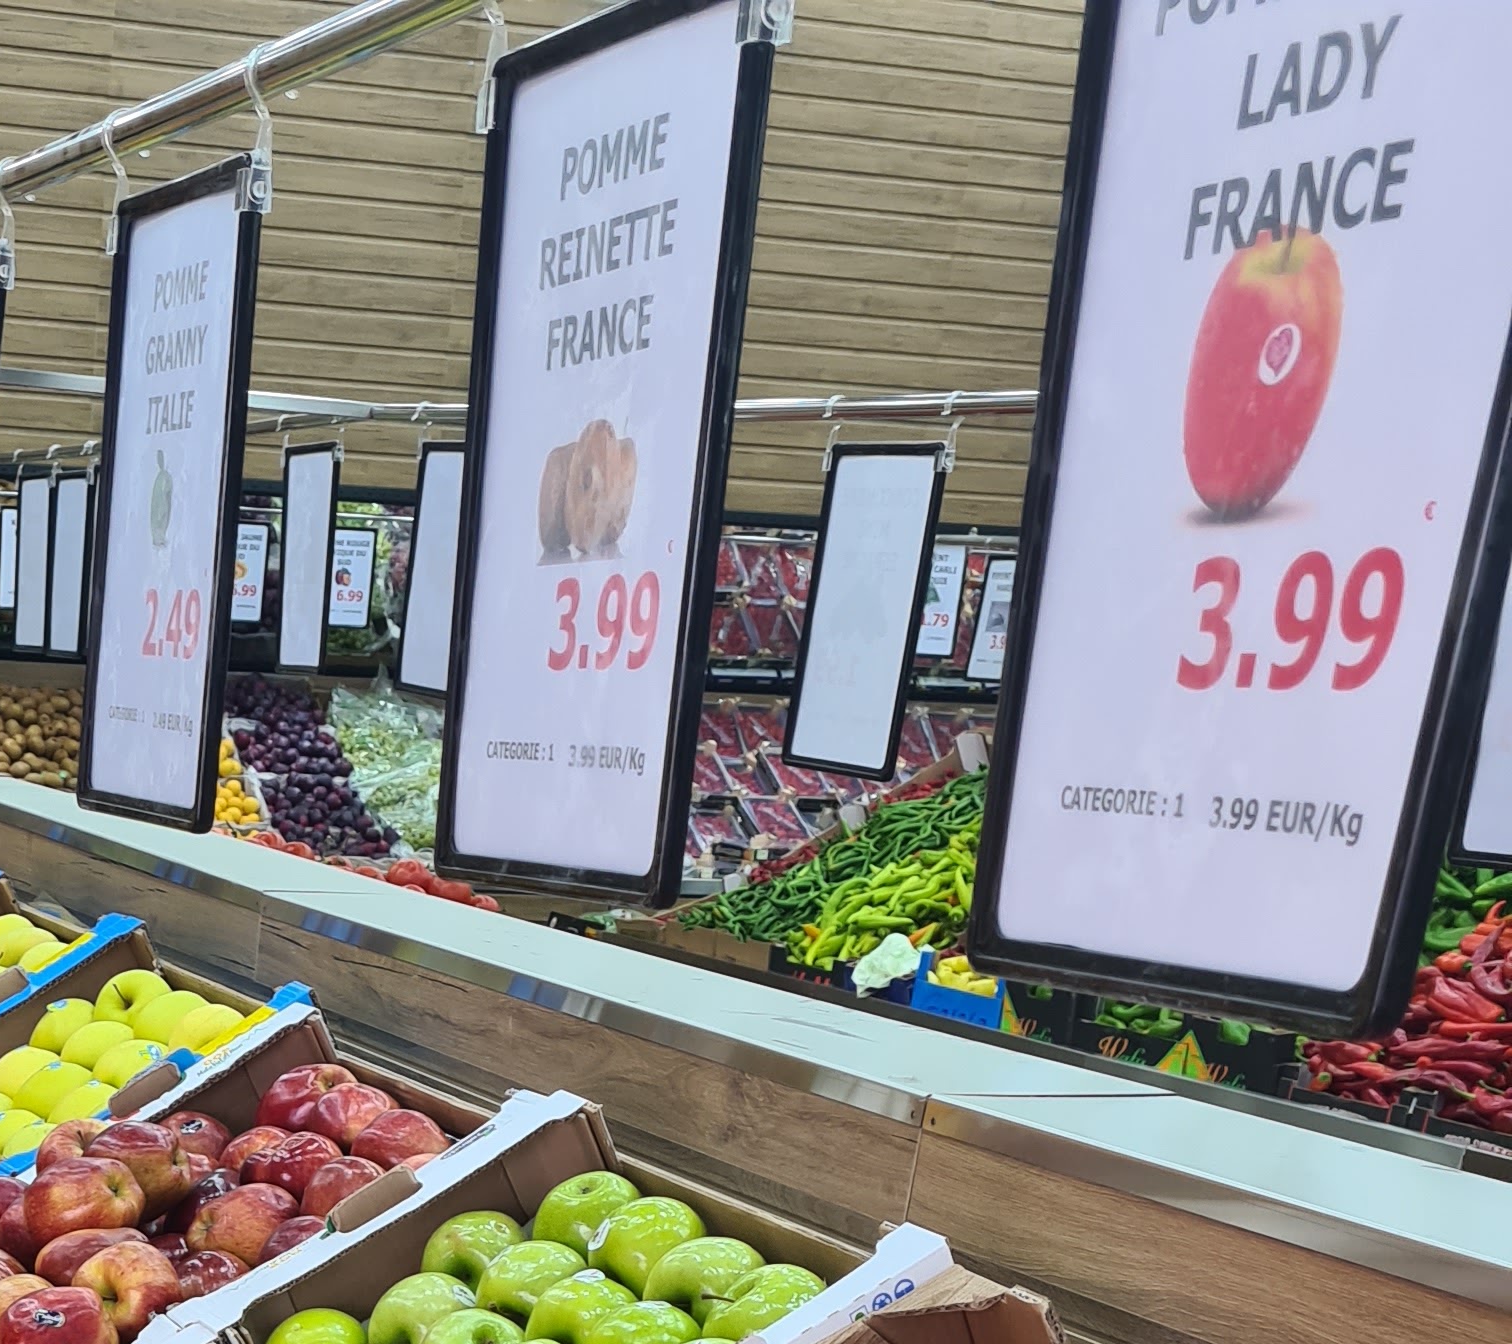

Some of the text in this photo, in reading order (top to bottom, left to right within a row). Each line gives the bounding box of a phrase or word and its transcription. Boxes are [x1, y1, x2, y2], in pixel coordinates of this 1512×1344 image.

[1236, 14, 1403, 130] LADY
[560, 112, 671, 202] POMME
[1183, 139, 1415, 262] FRANCE
[540, 199, 679, 290] REINETTE
[153, 260, 209, 312] POMME
[146, 324, 208, 375] GRANNY
[546, 294, 653, 373] FRANCE
[146, 390, 195, 434] ITALIE
[1424, 501, 1436, 521] €
[142, 589, 201, 659] 2.49
[337, 590, 364, 602] 6.99
[546, 569, 660, 673] 3.99
[1176, 547, 1405, 693] 3.99
[486, 740, 541, 764] CATEGORIE
[568, 743, 596, 768] 3.99
[598, 745, 646, 777] EUR/Kg
[1060, 785, 1159, 818] CATEGORIE
[1208, 797, 1258, 832] 3.99
[1265, 799, 1364, 847] EUR/Kg
